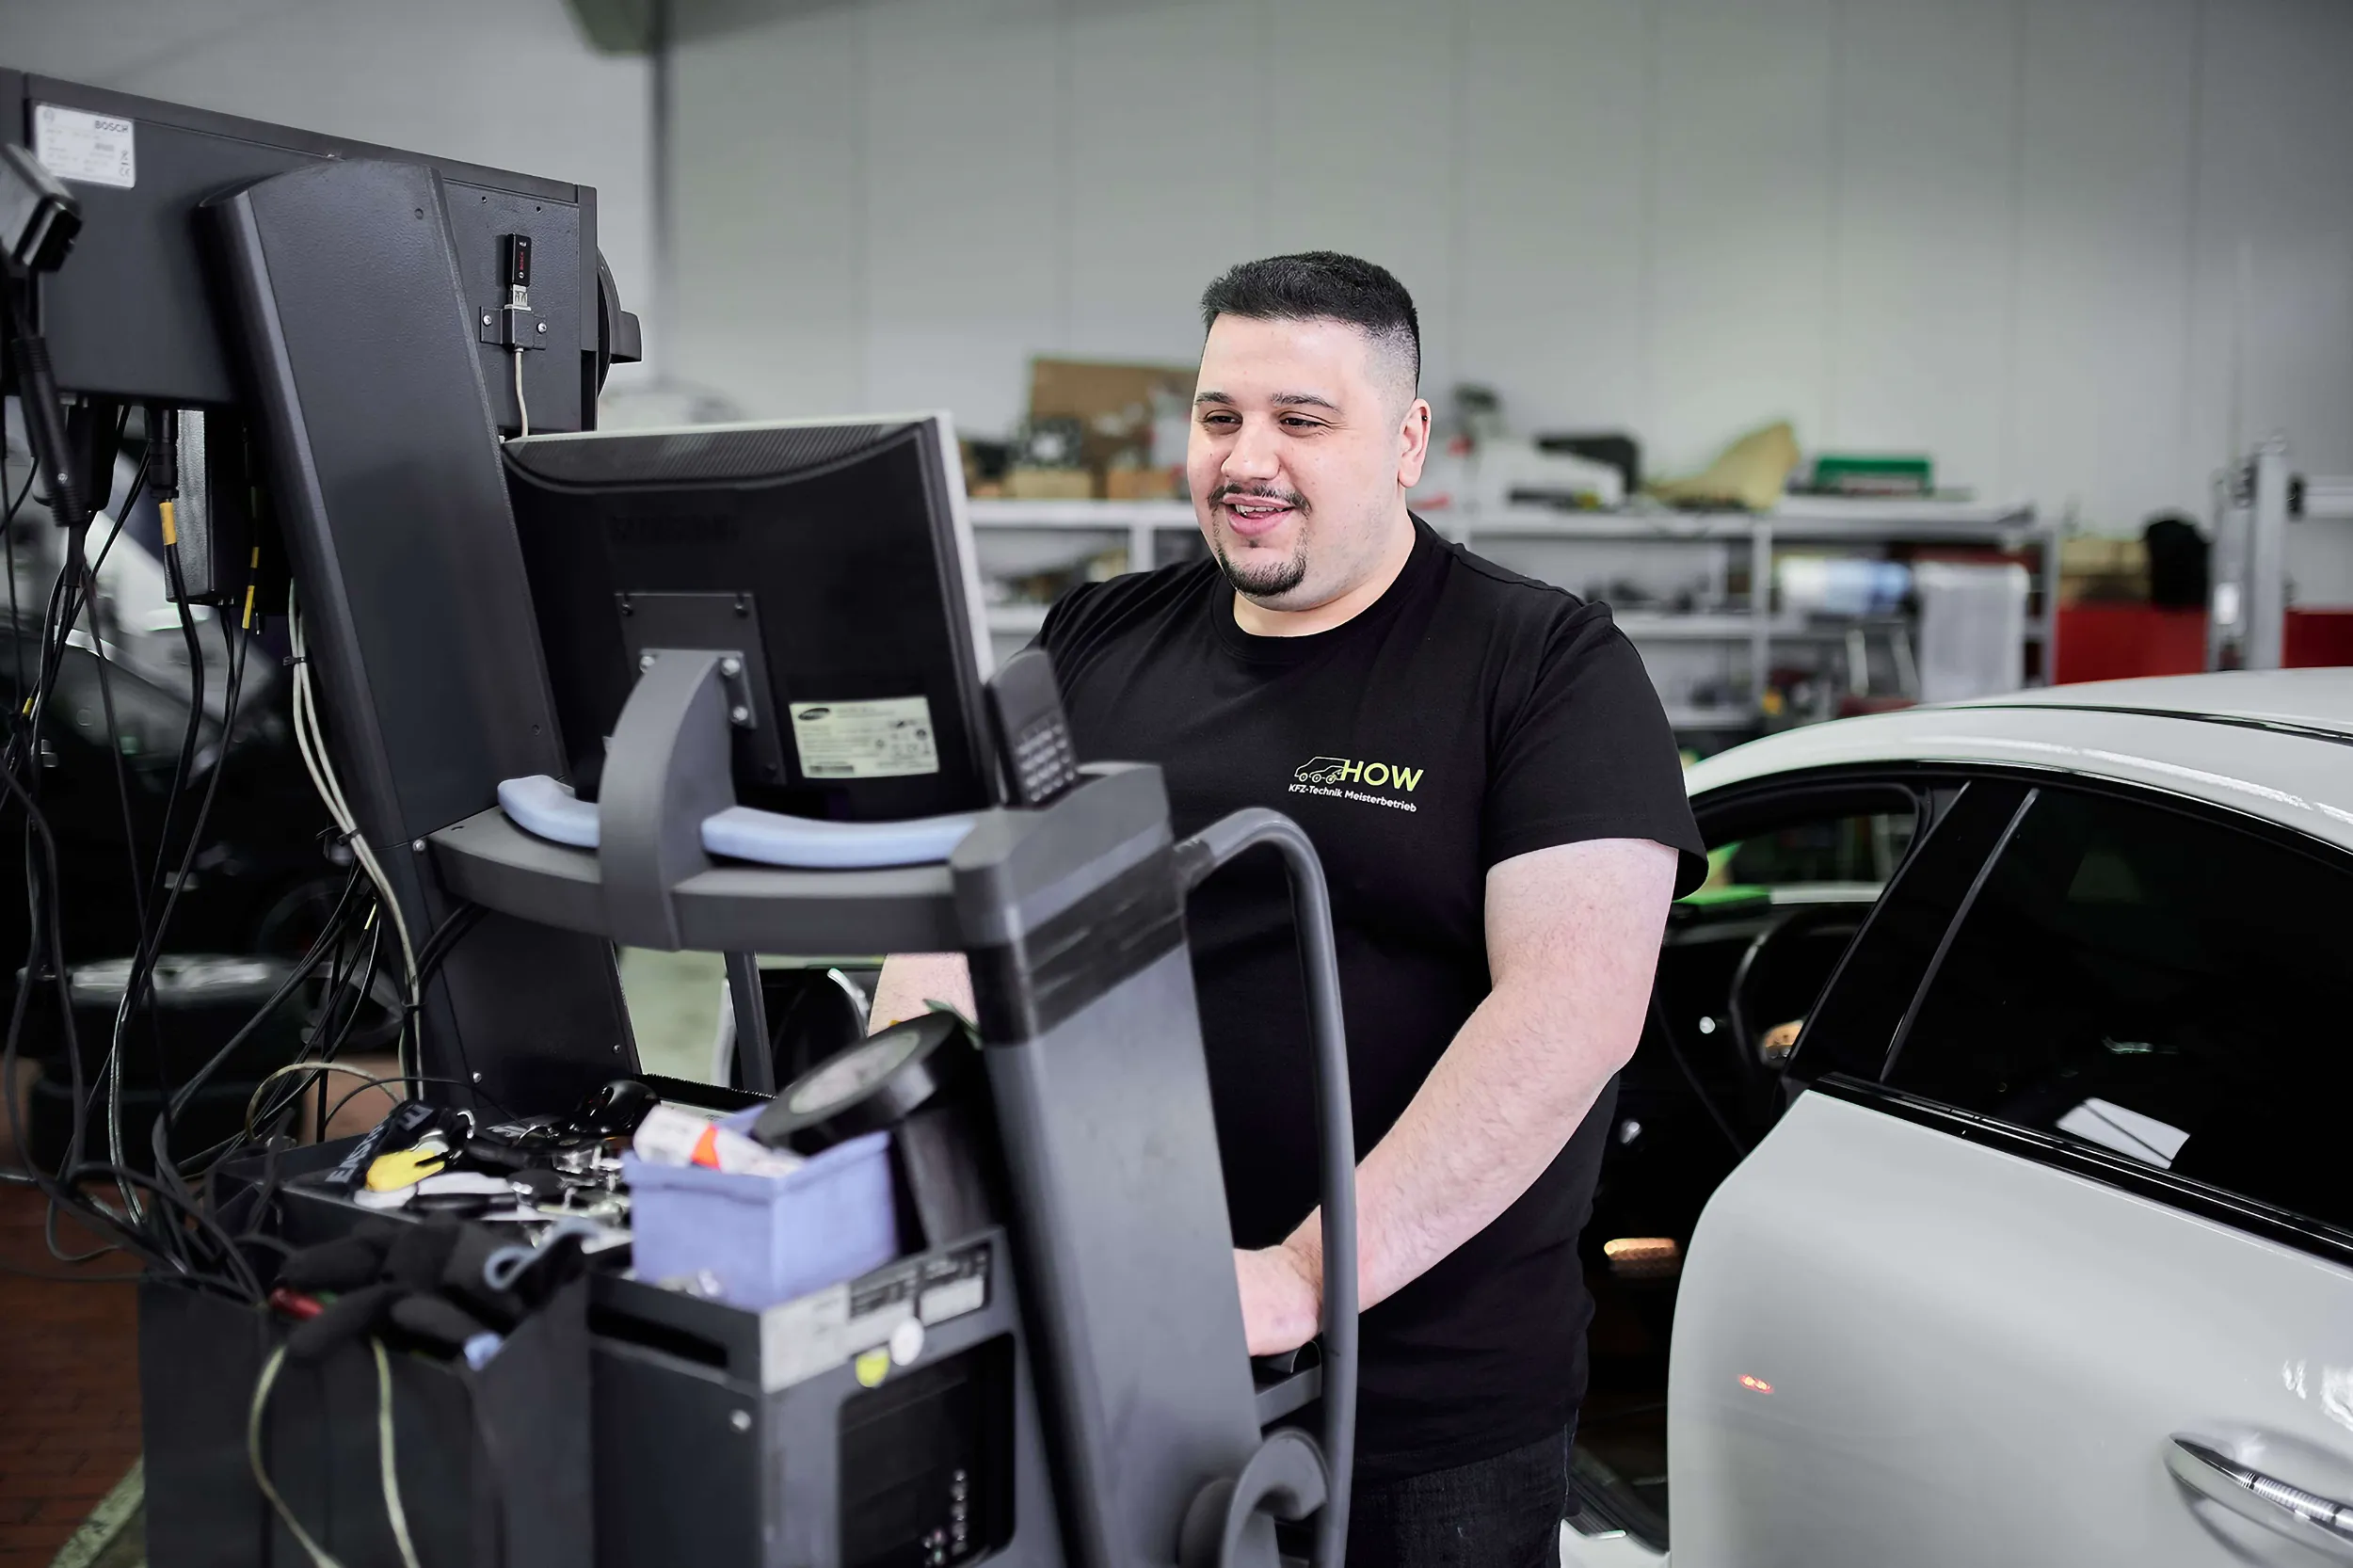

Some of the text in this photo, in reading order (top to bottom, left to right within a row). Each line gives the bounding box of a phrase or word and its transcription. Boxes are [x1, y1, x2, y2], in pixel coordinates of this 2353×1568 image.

[95, 120, 128, 133] BOSCH
[1340, 760, 1424, 792] HOW
[1289, 783, 1417, 812] KFZ-Technik Meisterbetrieb
